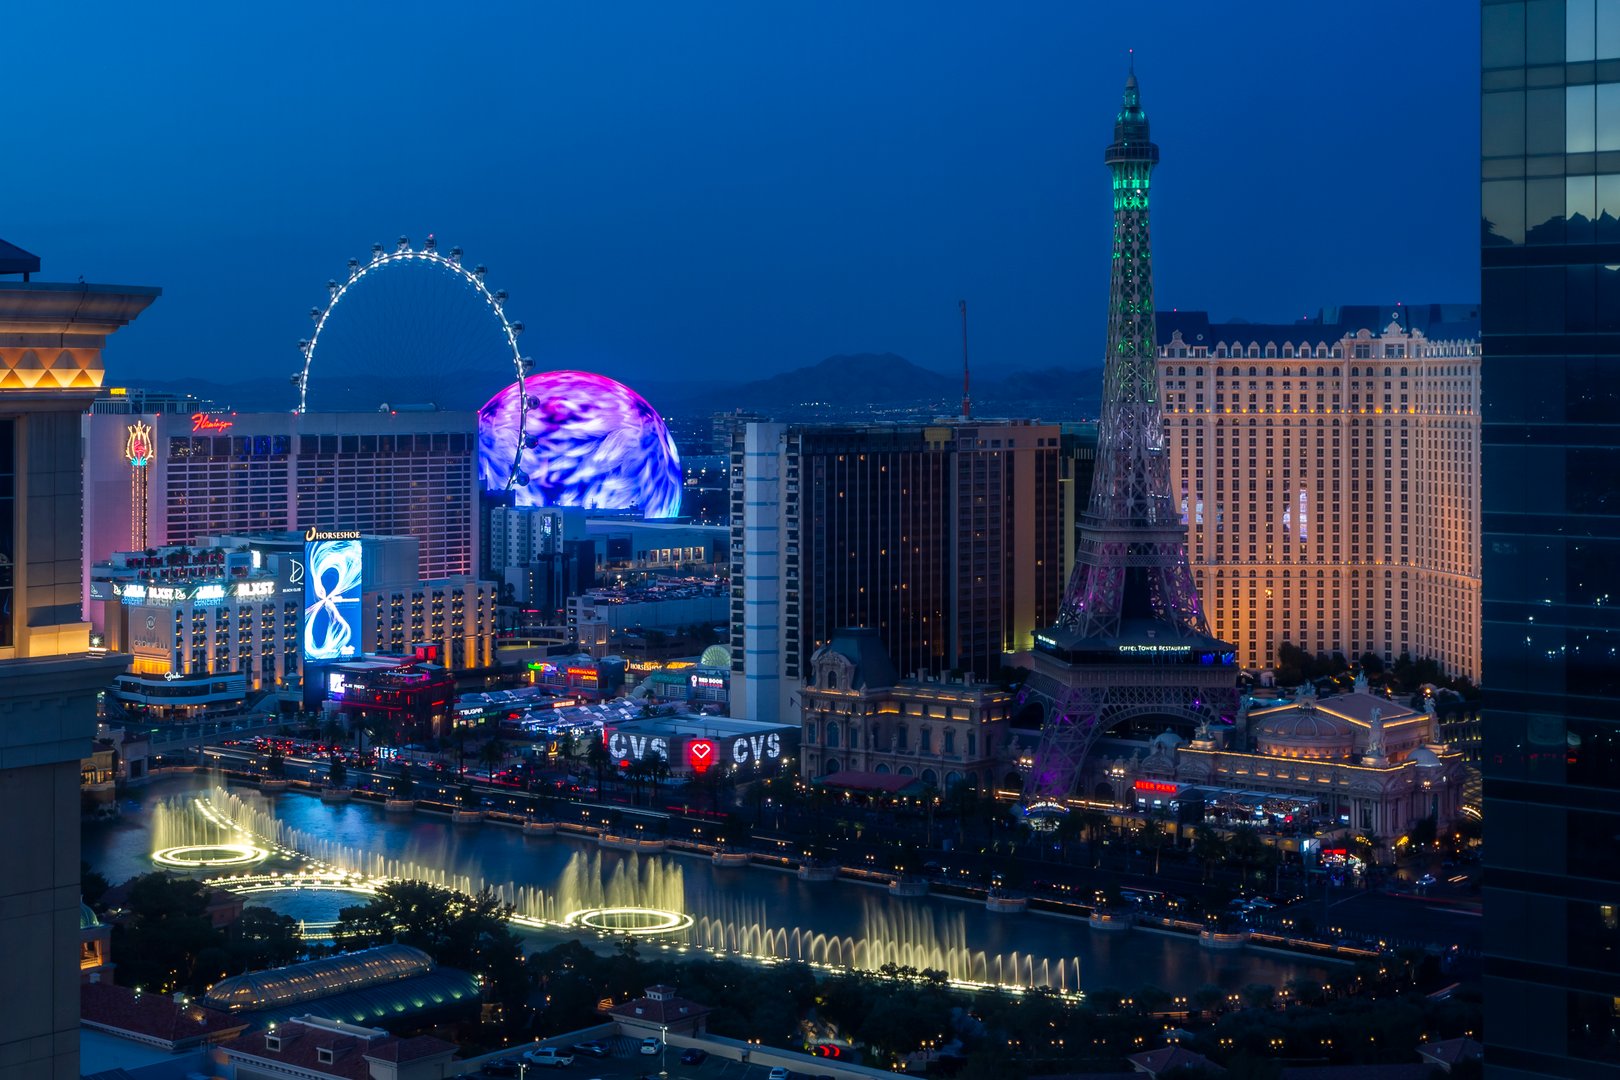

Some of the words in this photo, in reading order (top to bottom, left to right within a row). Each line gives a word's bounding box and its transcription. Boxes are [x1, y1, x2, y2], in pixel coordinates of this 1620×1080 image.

[191, 413, 232, 432] Flamingo
[315, 531, 361, 540] HORSESHOE
[609, 733, 668, 761] CVS
[733, 733, 781, 763] CVS
[1135, 781, 1155, 791] BEER
[1156, 783, 1177, 793] PARK
